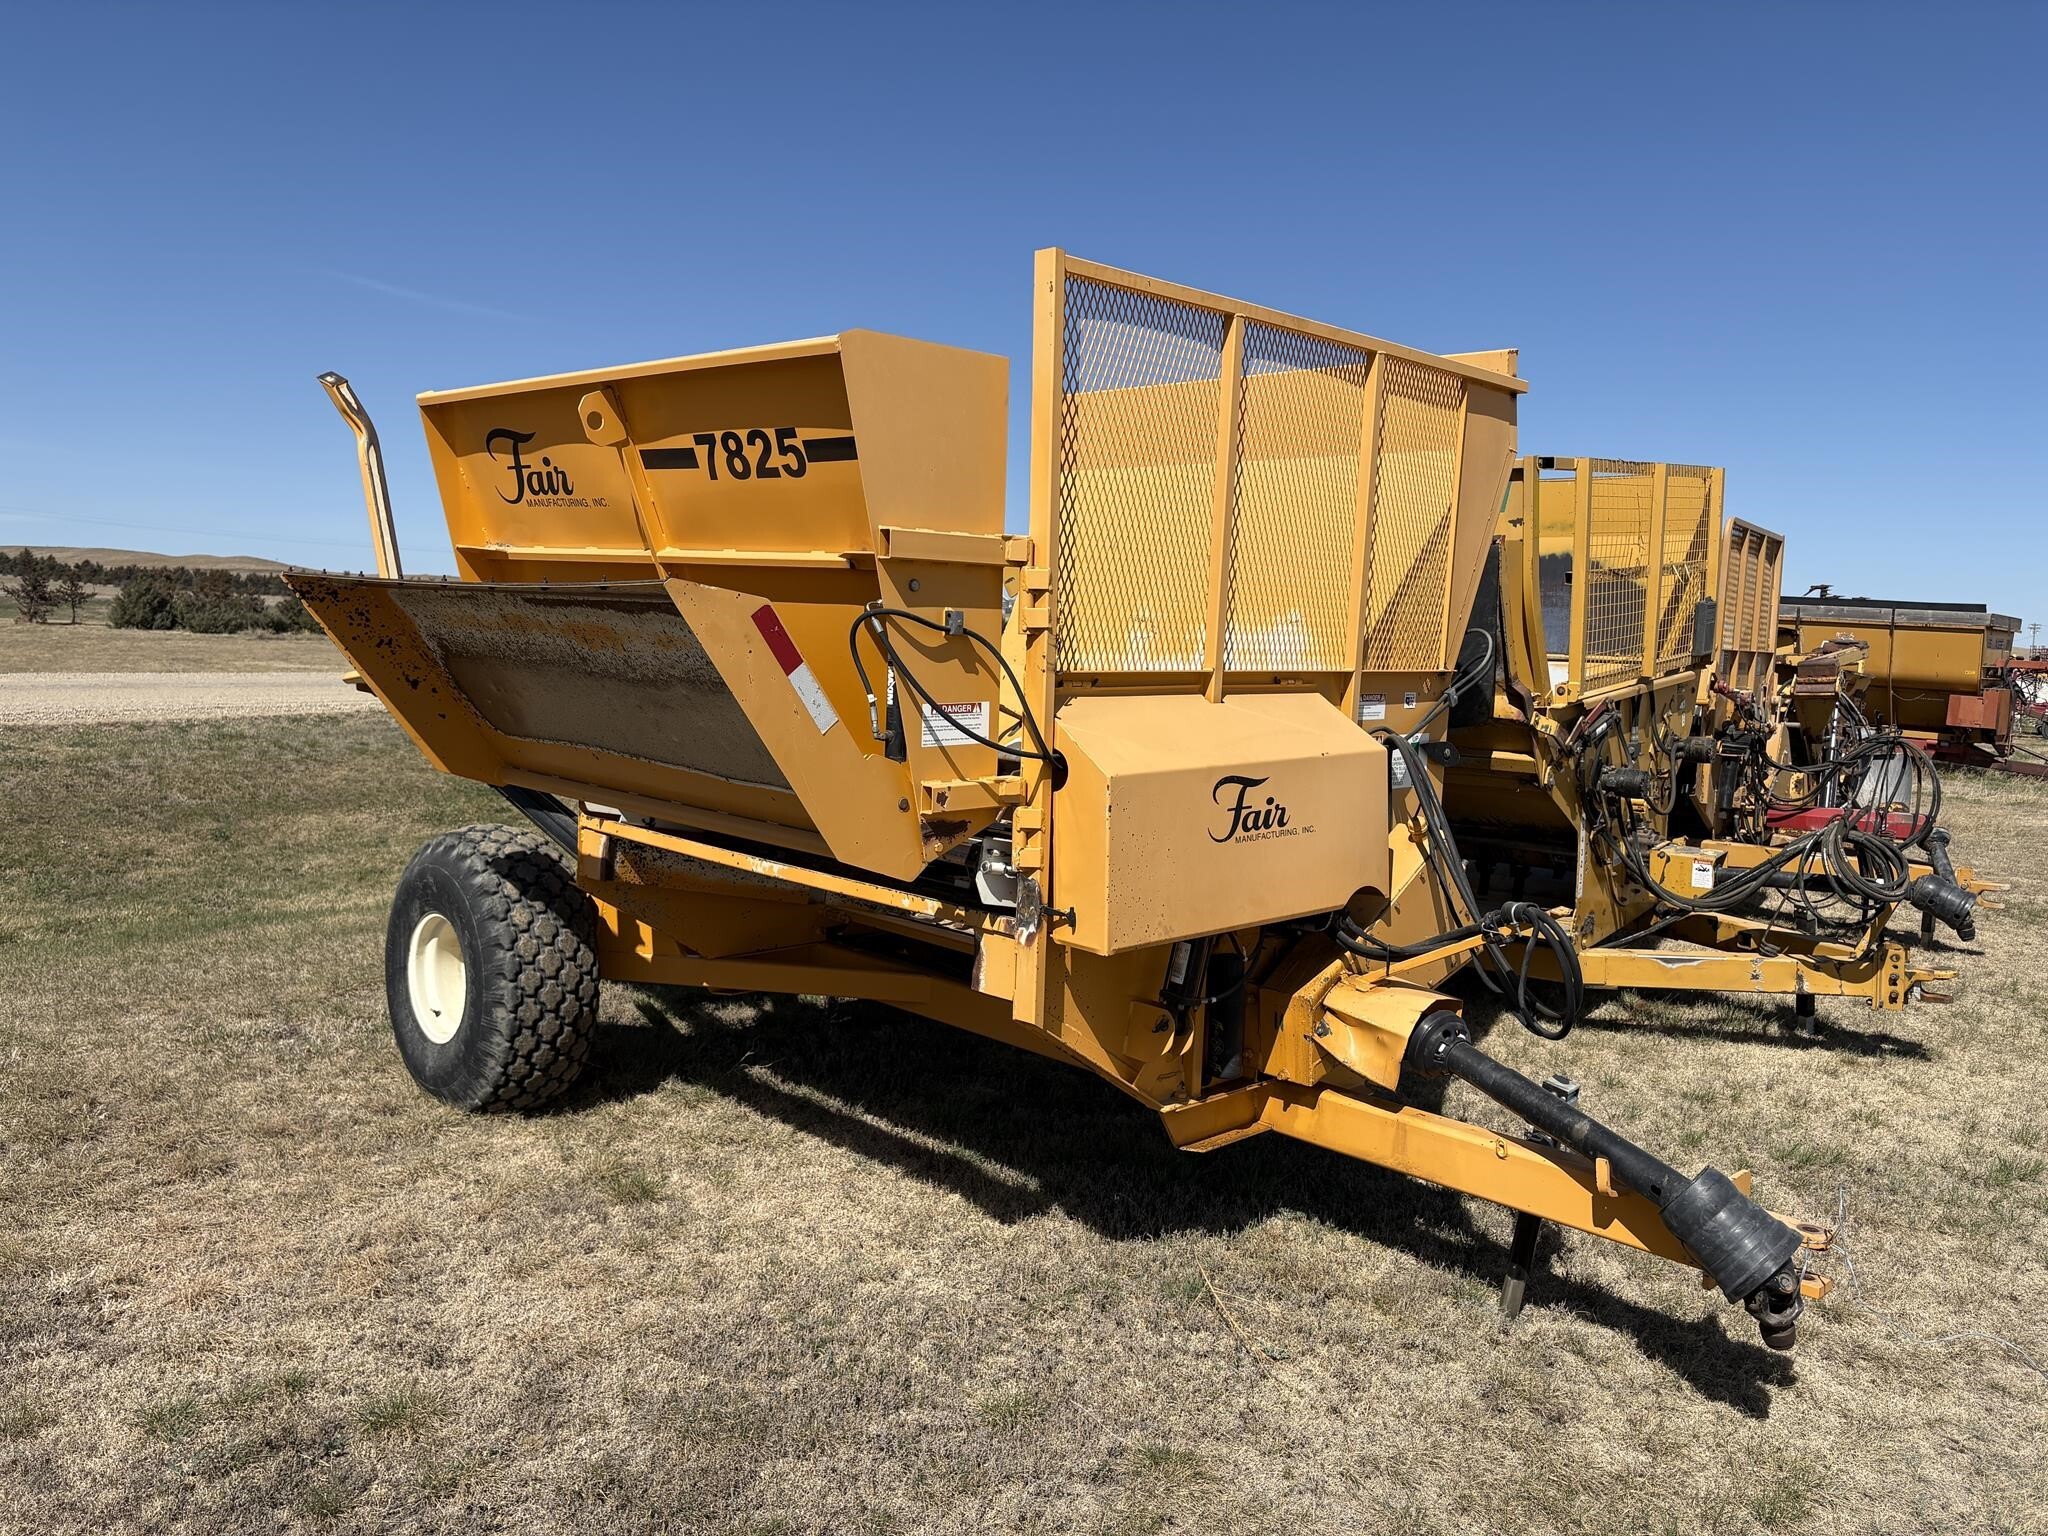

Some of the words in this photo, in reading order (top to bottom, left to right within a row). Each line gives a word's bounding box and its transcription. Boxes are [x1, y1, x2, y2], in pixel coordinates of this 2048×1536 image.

[485, 427, 575, 505] Fair
[692, 426, 807, 481] 7825
[525, 498, 592, 509] MANUFACTURING,
[592, 497, 610, 508] INC.
[941, 704, 972, 713] DANGER
[1207, 775, 1291, 844] Fair
[1234, 827, 1300, 844] MANUFACTURING,
[1301, 824, 1317, 834] INC.
